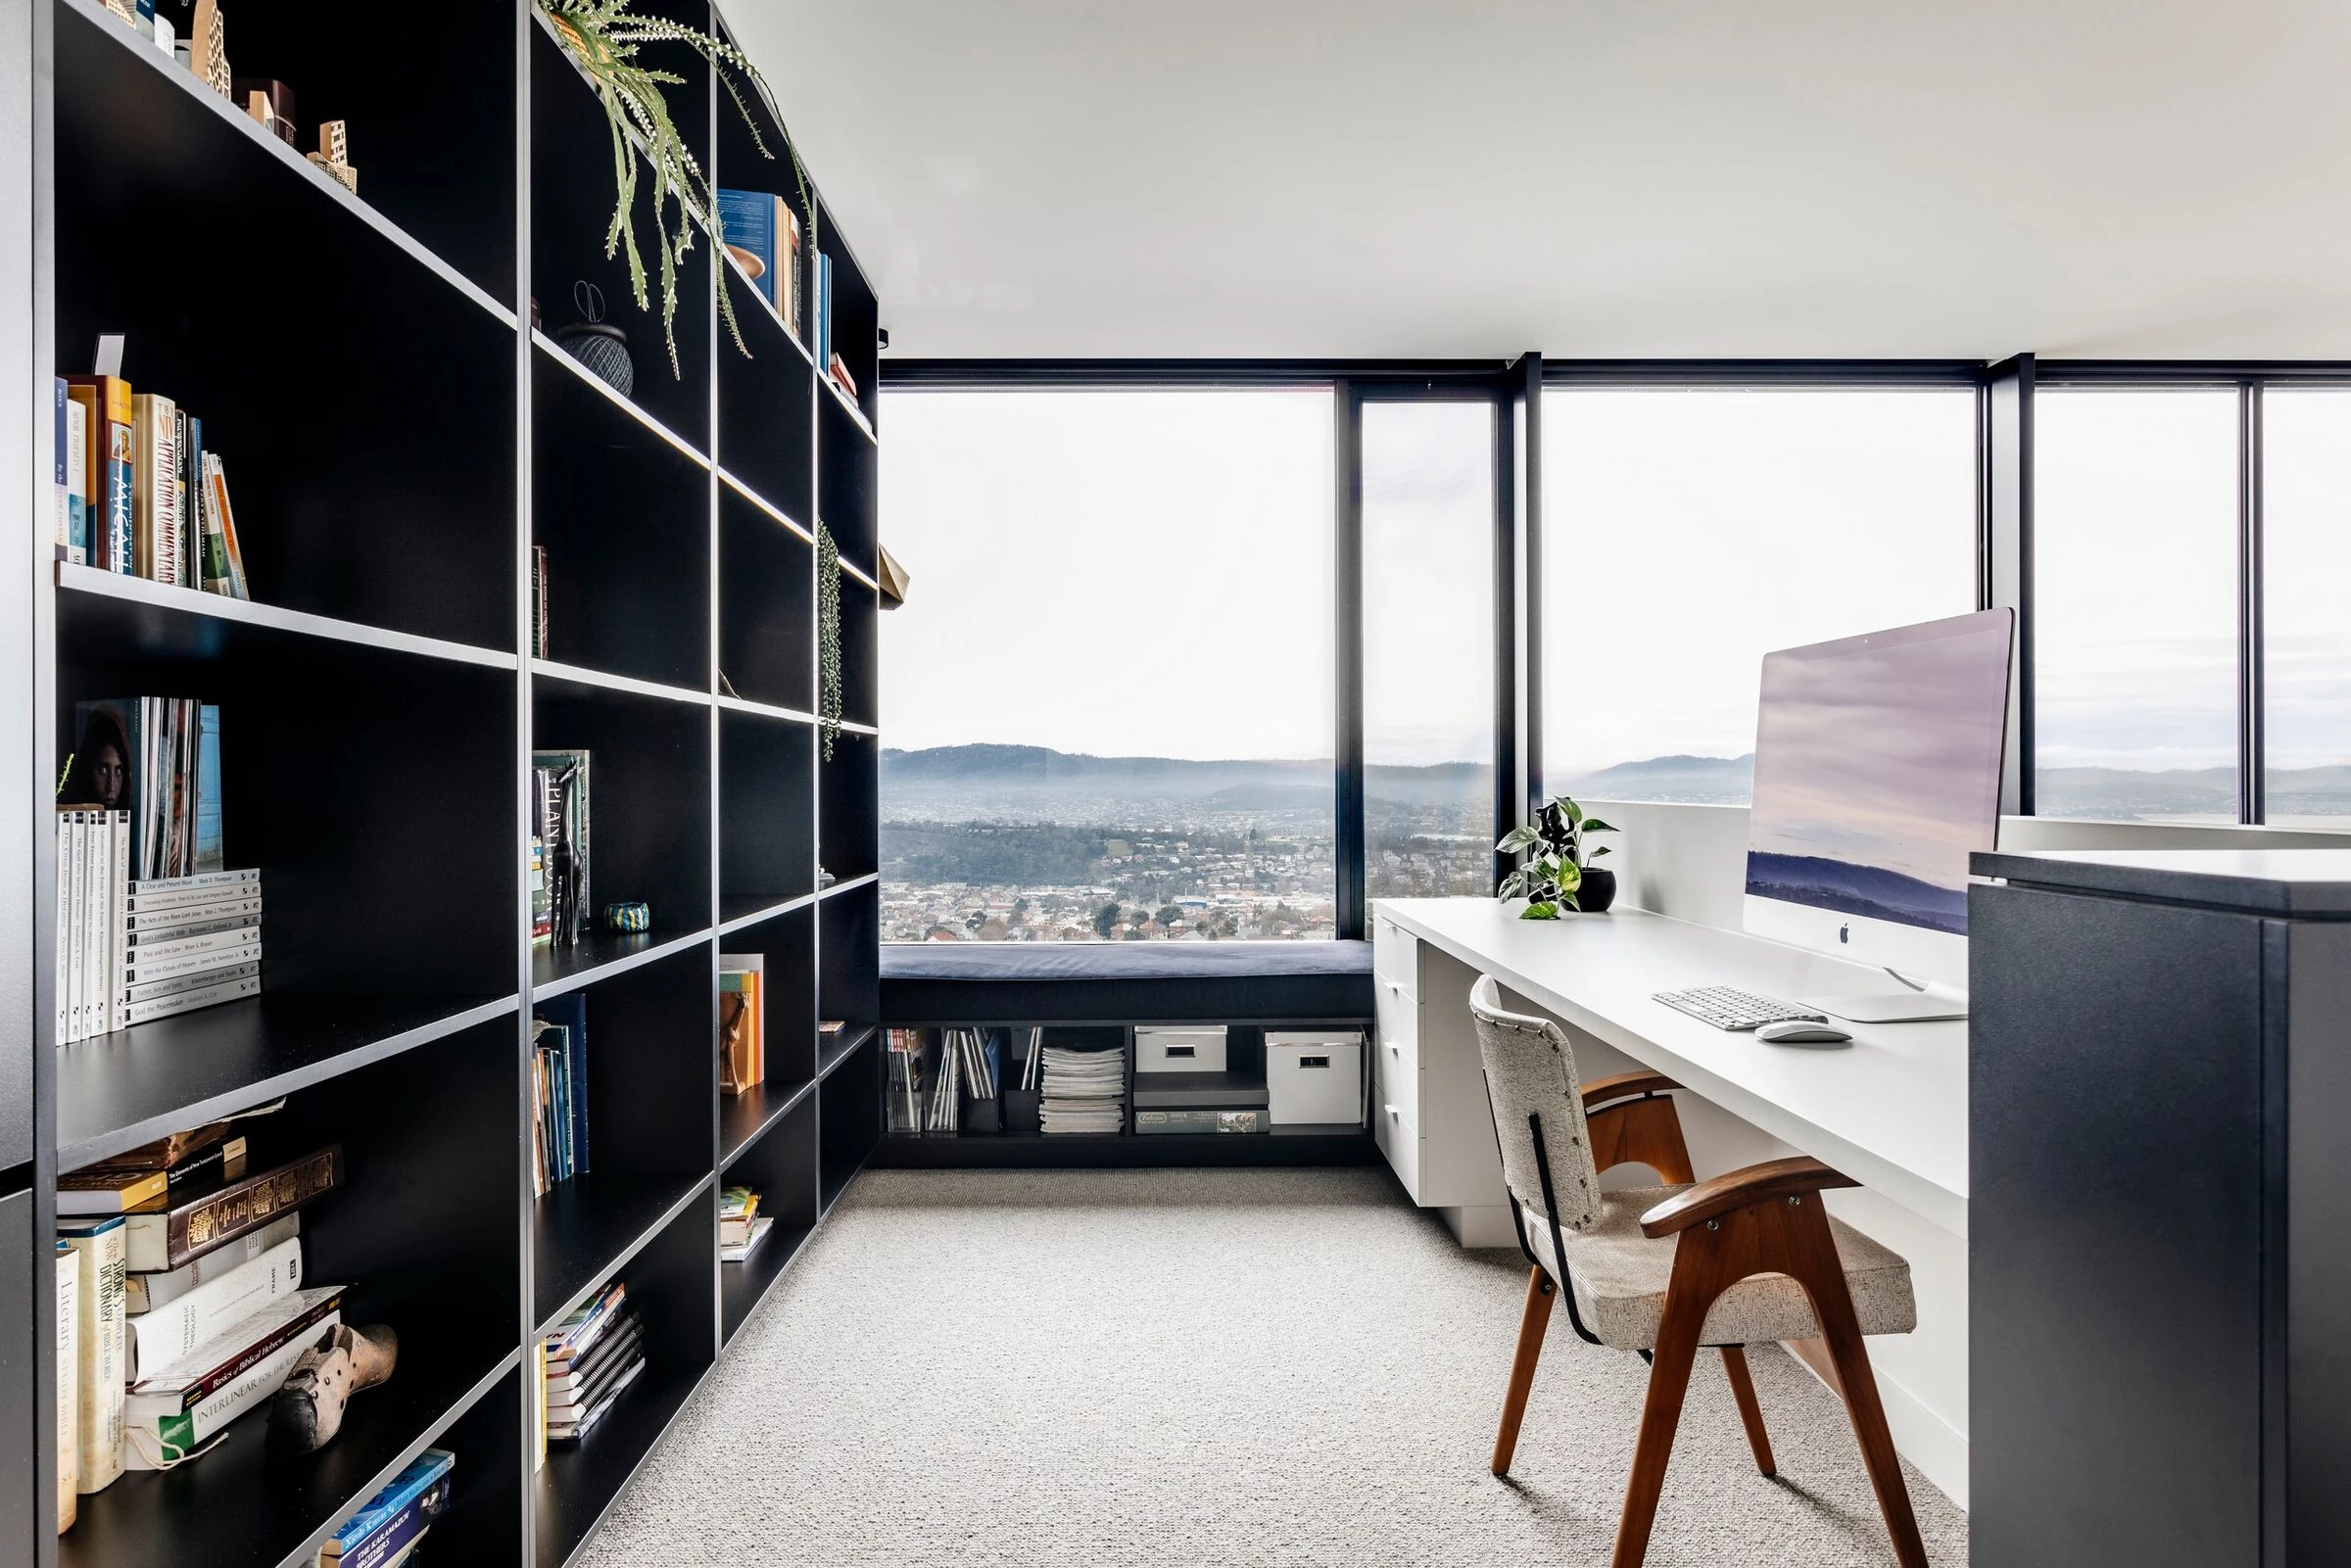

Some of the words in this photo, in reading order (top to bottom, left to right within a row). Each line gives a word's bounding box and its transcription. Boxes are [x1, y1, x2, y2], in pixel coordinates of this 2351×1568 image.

[175, 418, 184, 474] INTERPRETATION
[158, 440, 174, 510] APPLICATION
[158, 511, 174, 585] COMMENTARY
[157, 999, 184, 1011] Peacemaker
[100, 1263, 113, 1322] DICTIONARY
[114, 1258, 125, 1307] STRONG'S
[57, 1281, 72, 1352] Literary
[212, 1370, 233, 1389] Basics
[239, 1352, 264, 1372] Biblical
[263, 1337, 284, 1356] Hebrew
[198, 1379, 258, 1424] INTERLINEAR
[259, 1373, 272, 1383] FOR
[274, 1362, 284, 1373] THE
[345, 1527, 366, 1549] Nicole
[365, 1512, 388, 1530] Krauss
[356, 1538, 390, 1568] BROTHERS
[357, 1544, 371, 1561] THE
[371, 1509, 411, 1549] KARAMAZOV
